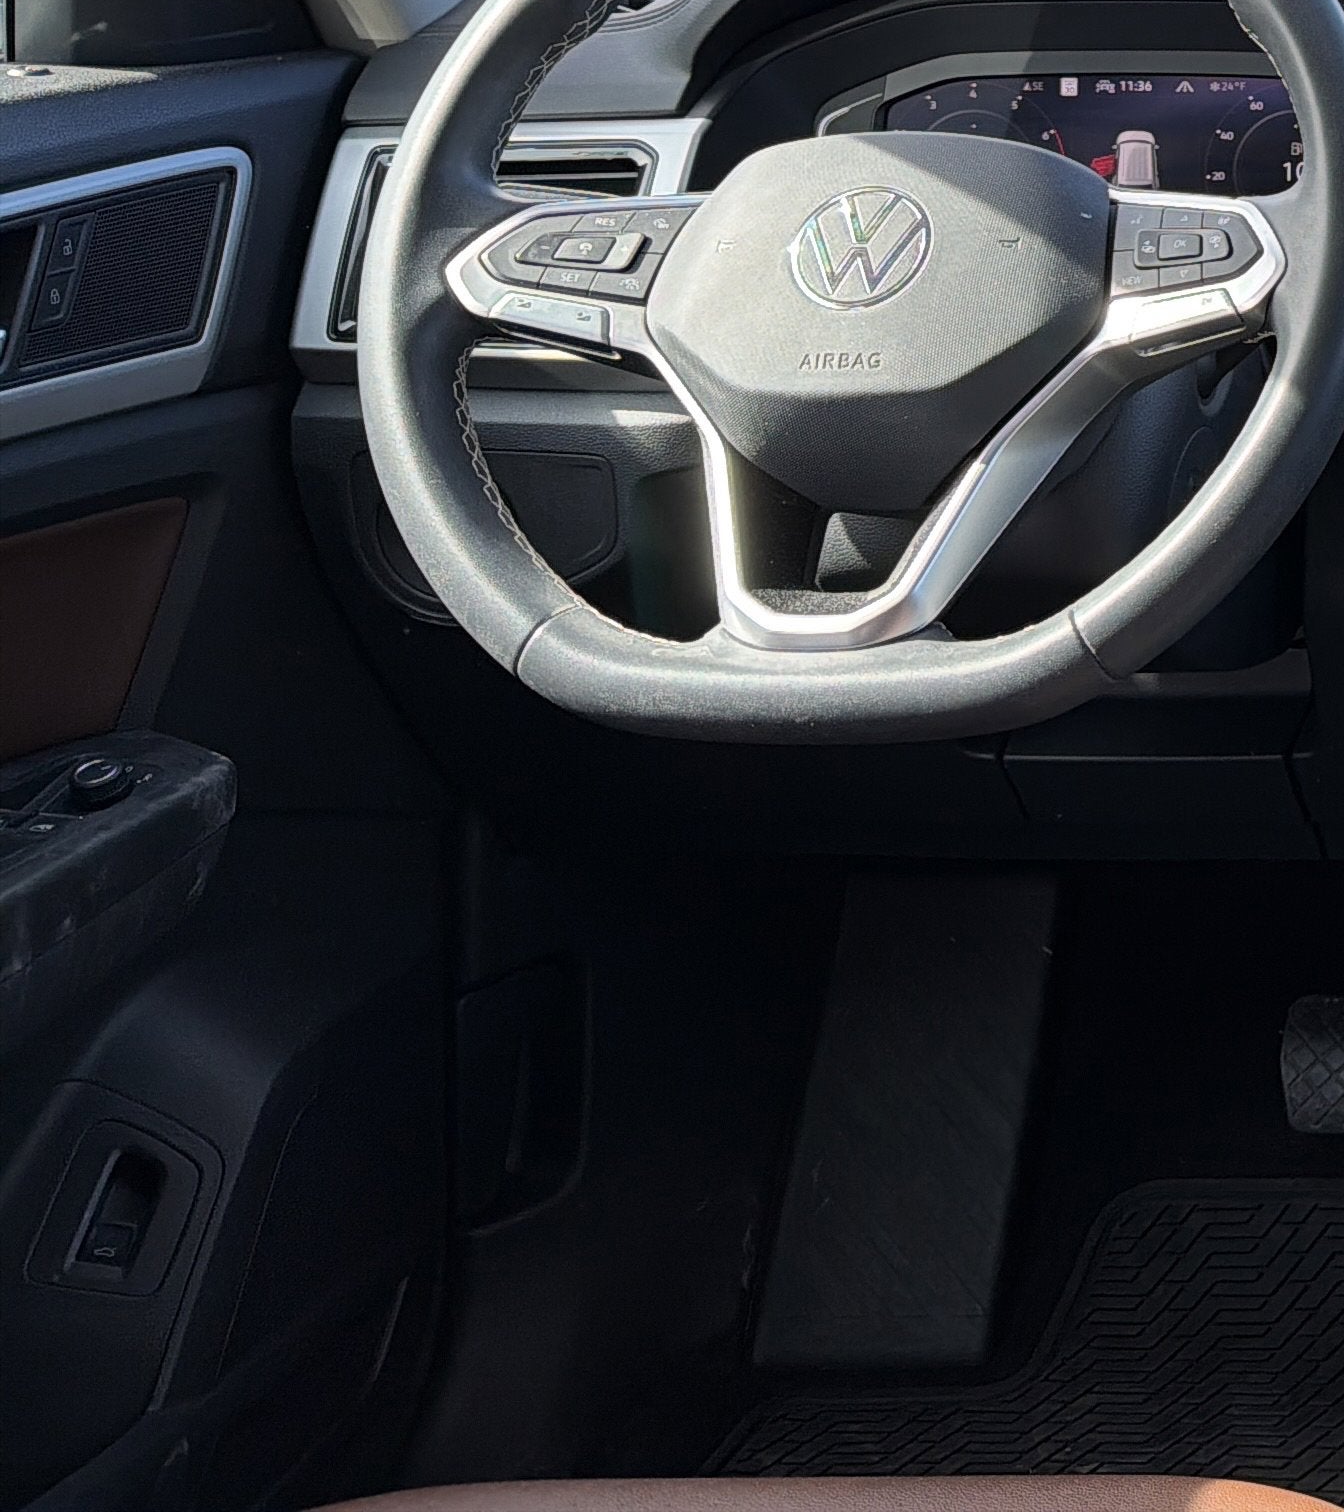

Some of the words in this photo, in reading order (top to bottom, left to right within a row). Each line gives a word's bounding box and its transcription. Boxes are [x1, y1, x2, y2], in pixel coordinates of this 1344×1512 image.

[1119, 80, 1152, 92] 11:36
[1010, 100, 1019, 110] 5
[1250, 101, 1264, 111] 60
[1041, 130, 1050, 141] 6
[1219, 131, 1235, 141] 40
[1211, 171, 1226, 181] 20
[594, 216, 617, 228] RES
[1173, 238, 1187, 249] OK
[560, 272, 581, 284] SET
[1121, 275, 1143, 286] VIEW
[798, 351, 883, 370] AIRBAG
